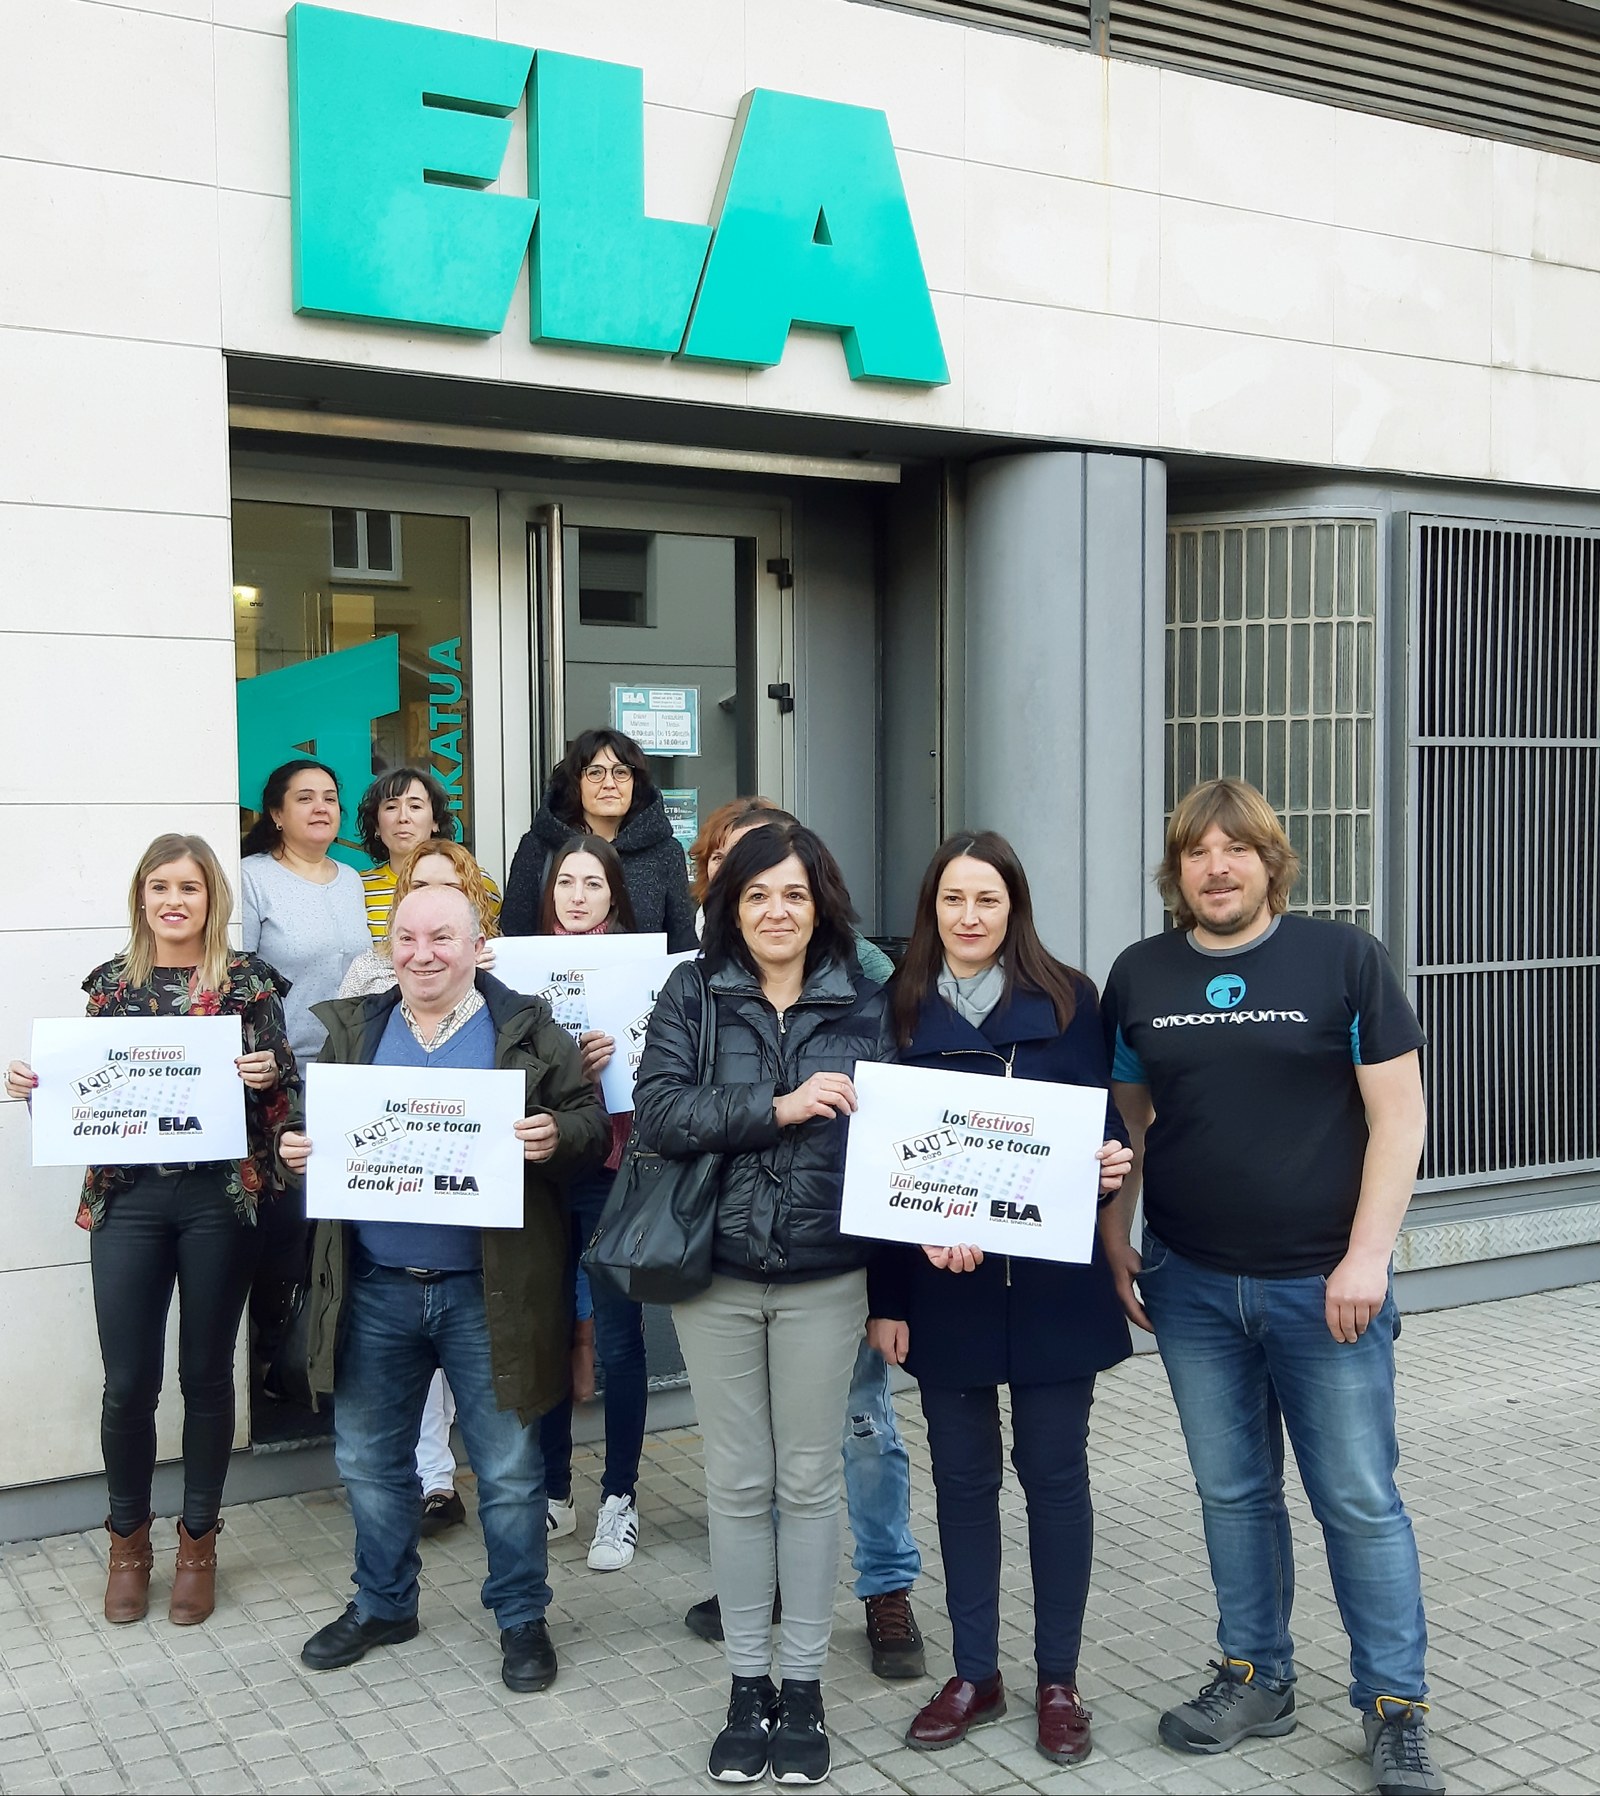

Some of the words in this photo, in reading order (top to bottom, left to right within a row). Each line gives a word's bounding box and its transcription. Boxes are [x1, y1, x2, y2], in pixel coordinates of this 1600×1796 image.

[287, 3, 950, 387] ELA
[551, 972, 567, 981] Los
[570, 970, 584, 981] fes
[541, 985, 562, 1002] UI
[567, 987, 581, 996] no
[108, 1049, 129, 1061] Los
[132, 1047, 182, 1061] festivos
[630, 1054, 641, 1065] Ja
[129, 1067, 145, 1077] no
[149, 1067, 163, 1077] se
[165, 1065, 202, 1077] tocan
[78, 1065, 124, 1096] AQUI
[74, 1108, 91, 1119] Jai
[93, 1108, 147, 1121] egunetan
[386, 1099, 408, 1113] Los
[410, 1100, 463, 1114] festivos
[73, 1121, 121, 1136] denok
[121, 1121, 149, 1138] jai!
[158, 1116, 203, 1131] ELA
[406, 1121, 423, 1131] no
[426, 1121, 441, 1132] se
[444, 1120, 481, 1133] tocan
[942, 1109, 967, 1126] Los
[970, 1113, 1031, 1134] festivos
[353, 1117, 400, 1148] AQUI
[902, 1130, 957, 1161] AQUI
[964, 1136, 984, 1148] no
[986, 1139, 1004, 1151] se
[1007, 1139, 1051, 1157] tocan
[348, 1161, 366, 1172] Jai
[368, 1163, 423, 1176] egunetan
[347, 1175, 395, 1191] denok
[395, 1178, 424, 1195] jai!
[434, 1175, 480, 1192] ELA
[891, 1175, 913, 1189] Jai
[914, 1180, 979, 1197] egunetan
[889, 1191, 945, 1213] denok
[943, 1198, 979, 1219] jai!
[990, 1199, 1043, 1223] ELA
